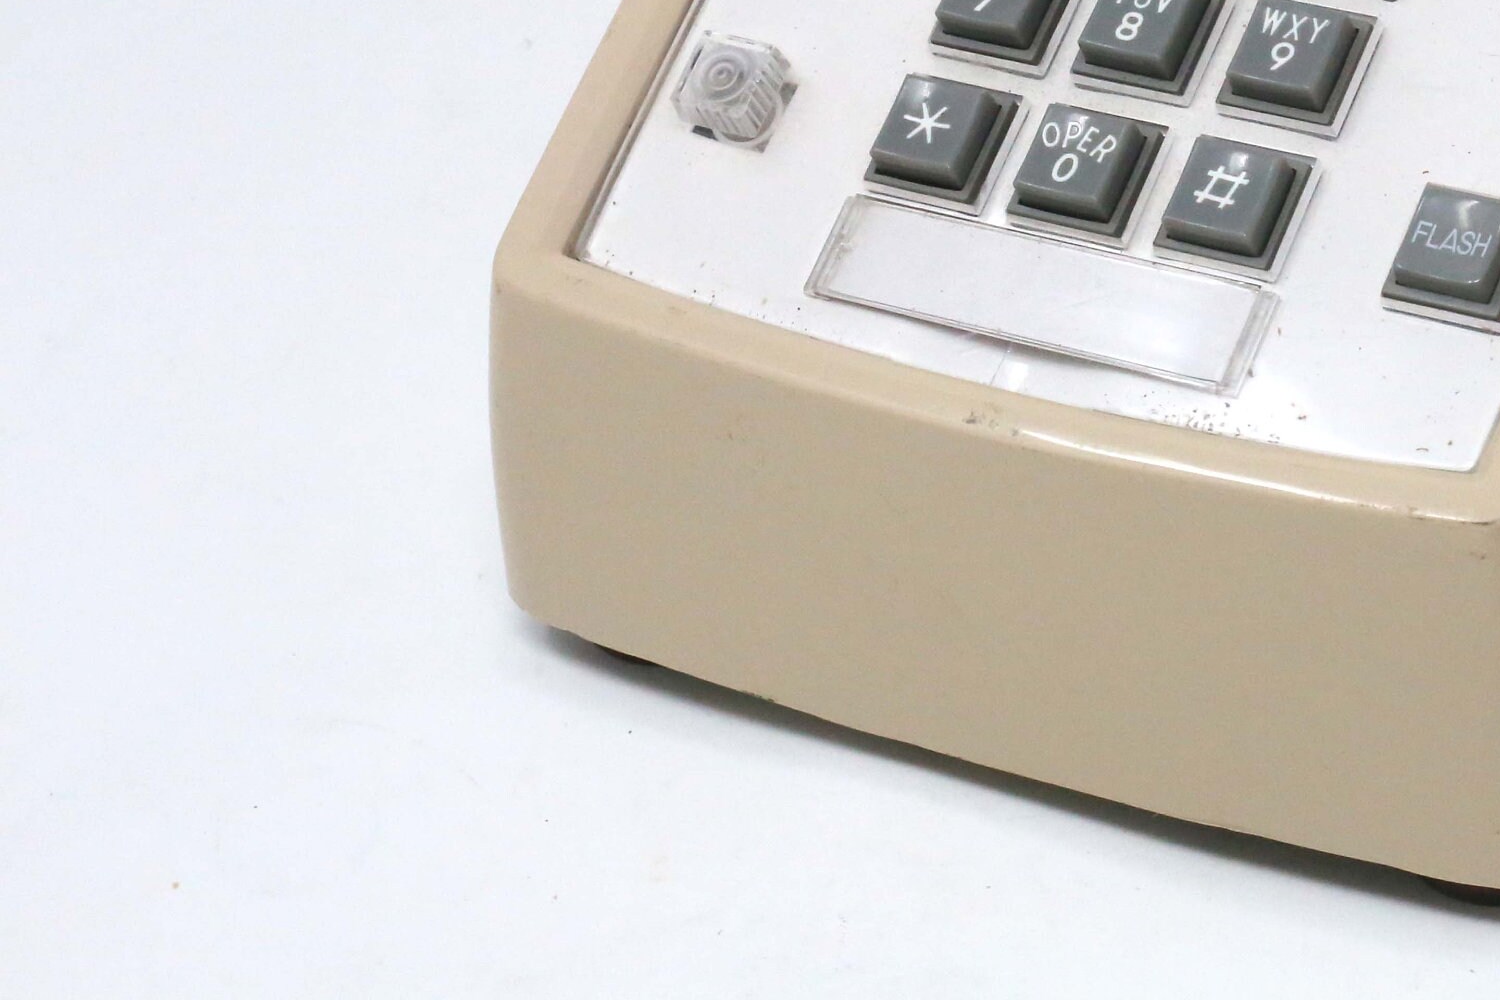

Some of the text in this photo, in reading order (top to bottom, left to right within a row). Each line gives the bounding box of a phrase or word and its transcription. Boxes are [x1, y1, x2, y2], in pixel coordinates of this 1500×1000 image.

[1115, 13, 1141, 40] 8
[1261, 7, 1330, 43] WXY
[1269, 44, 1295, 70] 9
[1042, 120, 1117, 163] OPER
[1411, 220, 1492, 257] FLASH
